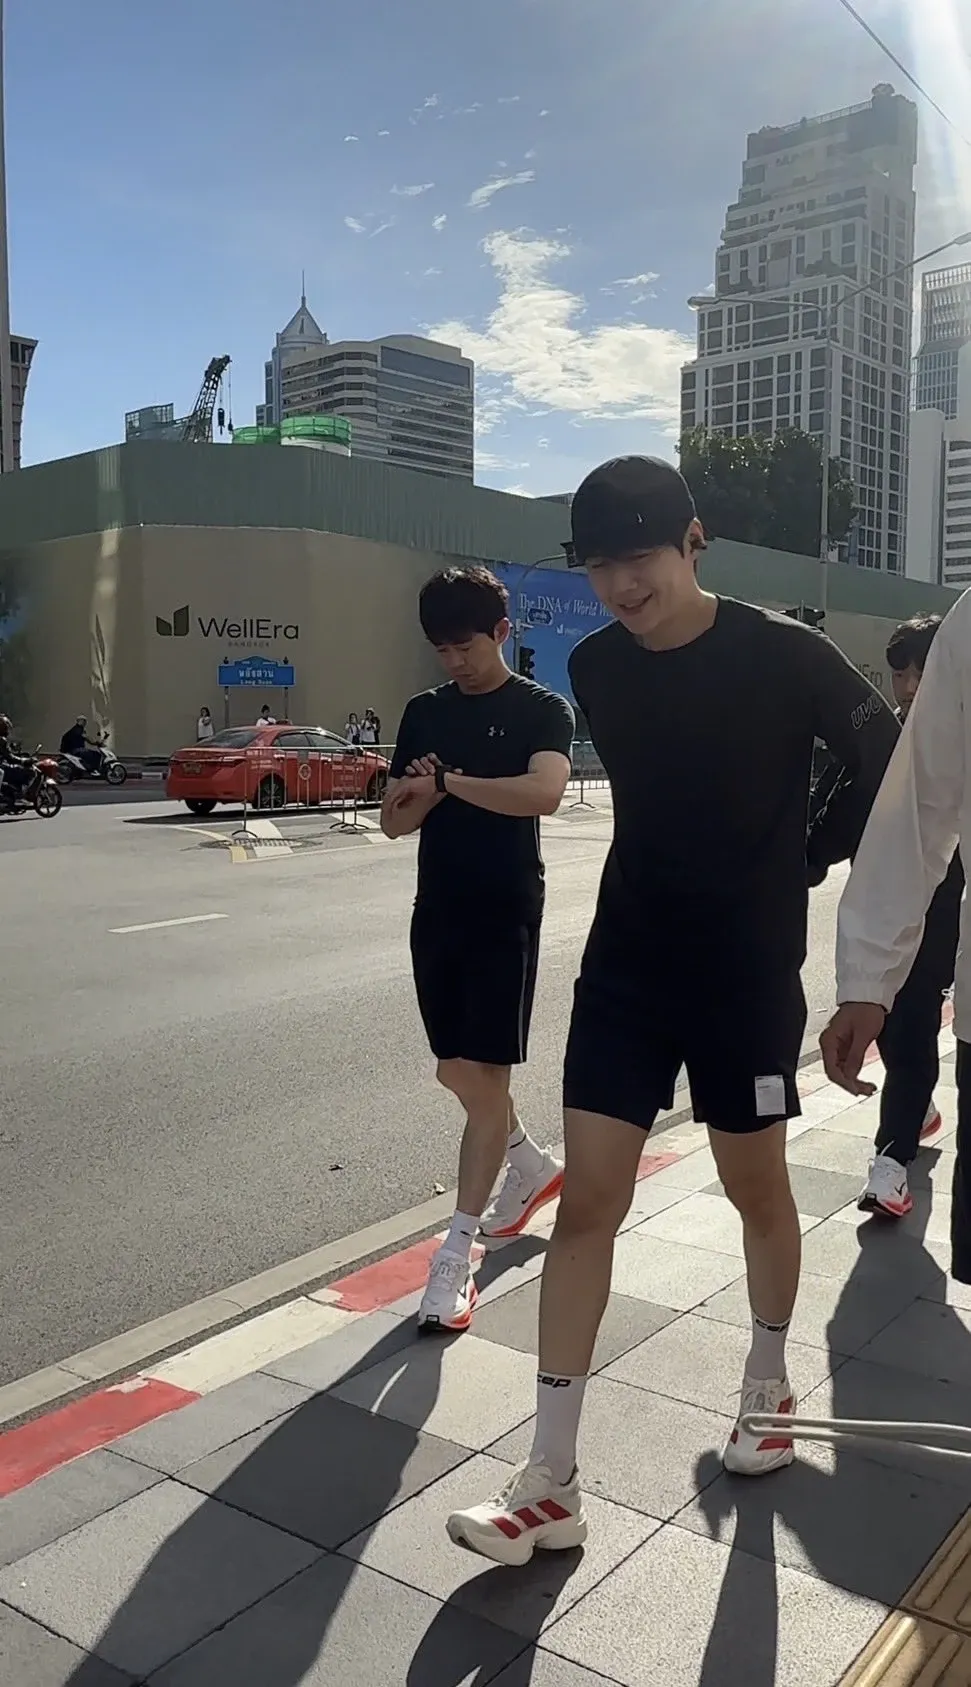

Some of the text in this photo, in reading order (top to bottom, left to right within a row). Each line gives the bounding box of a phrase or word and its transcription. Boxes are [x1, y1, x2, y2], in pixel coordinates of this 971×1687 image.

[538, 596, 562, 614] DNA
[573, 599, 599, 617] World
[197, 616, 300, 640] WellEra
